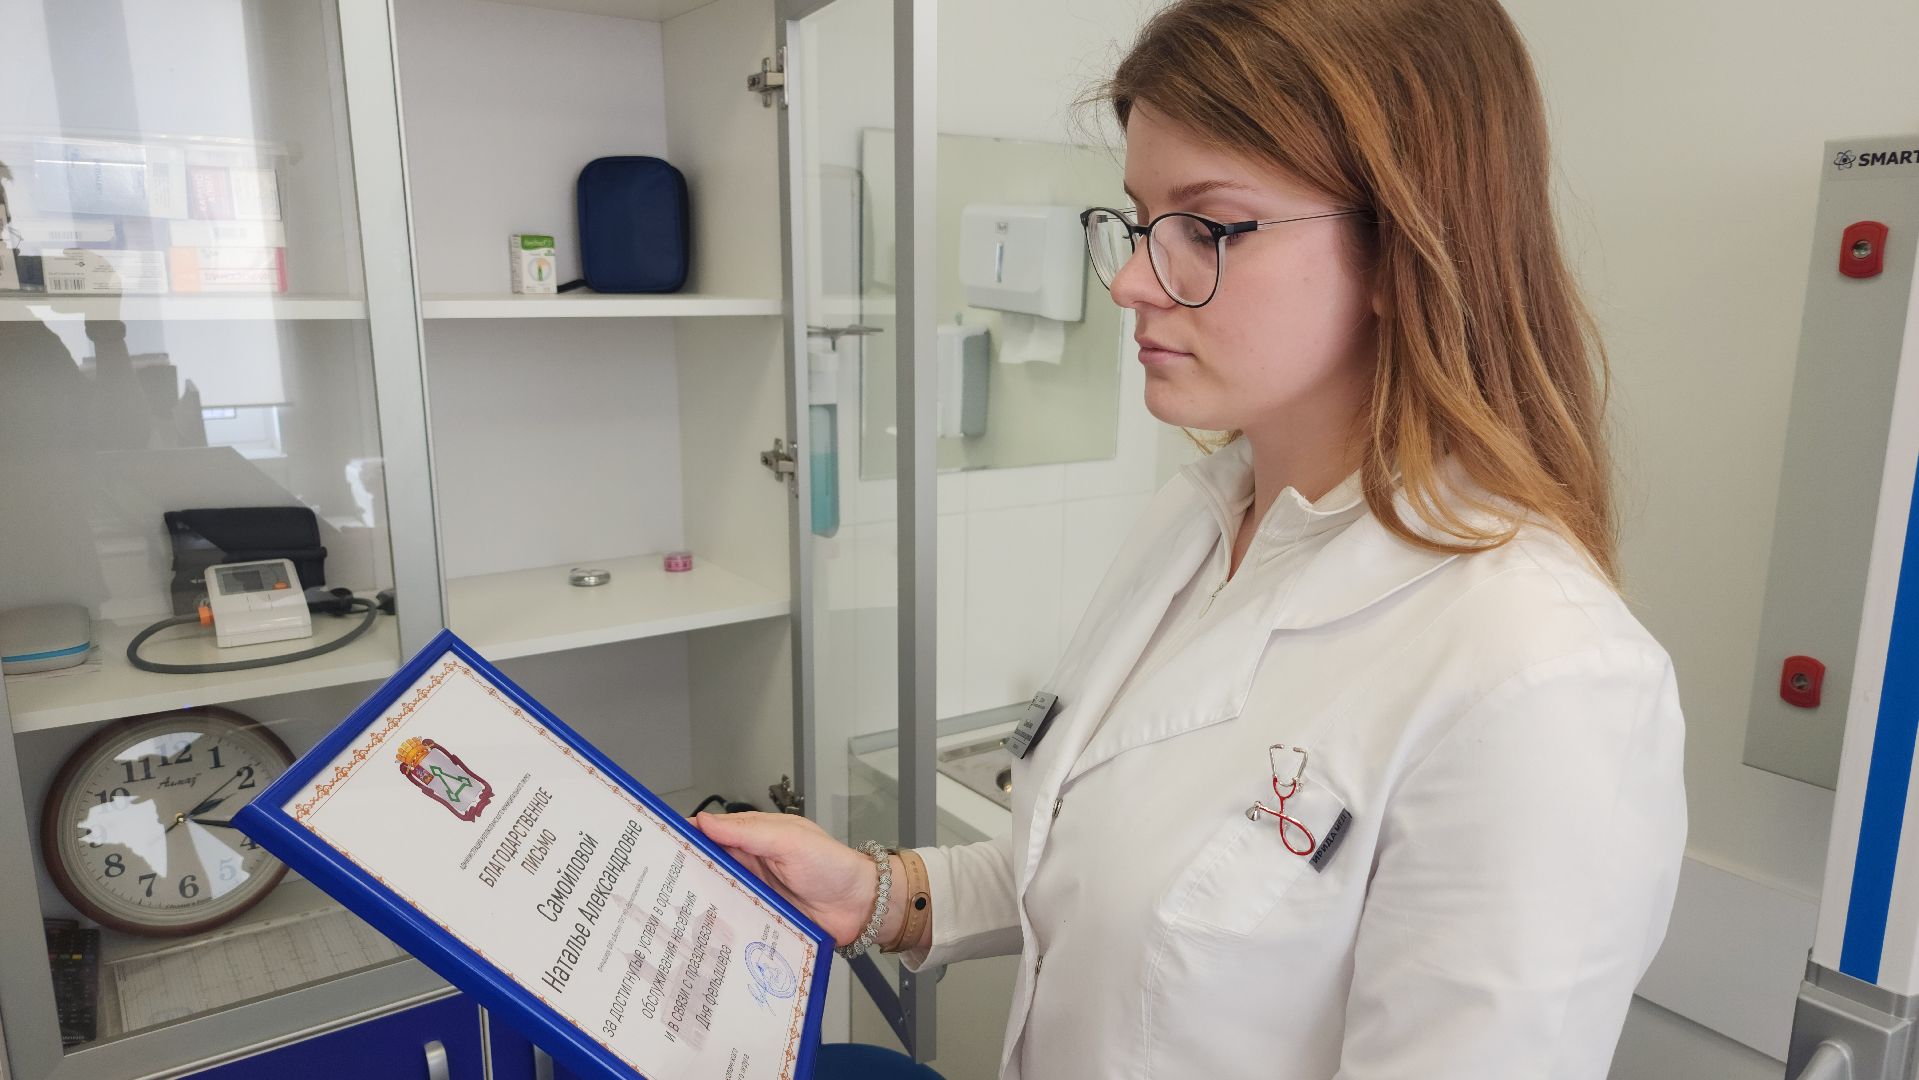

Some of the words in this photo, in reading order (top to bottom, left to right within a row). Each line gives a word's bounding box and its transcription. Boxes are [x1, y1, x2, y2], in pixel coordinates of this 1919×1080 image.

[155, 740, 193, 767] 12
[207, 745, 225, 770] 1
[120, 756, 157, 784] 11
[237, 765, 256, 790] 2
[478, 786, 553, 889] БЛАГОДАРСТВЕННОЕ
[520, 828, 557, 876] ПИСЬМО
[1312, 832, 1337, 864] ИРИДА
[104, 853, 126, 878] 8
[536, 830, 600, 923] Самойловой
[656, 849, 688, 908] организации
[138, 872, 158, 898] 7
[178, 874, 200, 899] 6
[541, 922, 591, 994] Наталье
[577, 819, 643, 926] Александровне
[652, 905, 665, 916] в
[637, 913, 661, 955] успехи
[685, 903, 718, 981] празднованием
[641, 940, 679, 1019] обслуживания
[670, 890, 697, 944] населения
[609, 949, 646, 1024] достигнутые
[681, 978, 693, 989] с
[702, 944, 732, 1007] фельдшера
[671, 987, 691, 1022] связи
[694, 1003, 714, 1032] Дня
[602, 1019, 618, 1039] за
[664, 1030, 676, 1044] и
[667, 1021, 681, 1033] в
